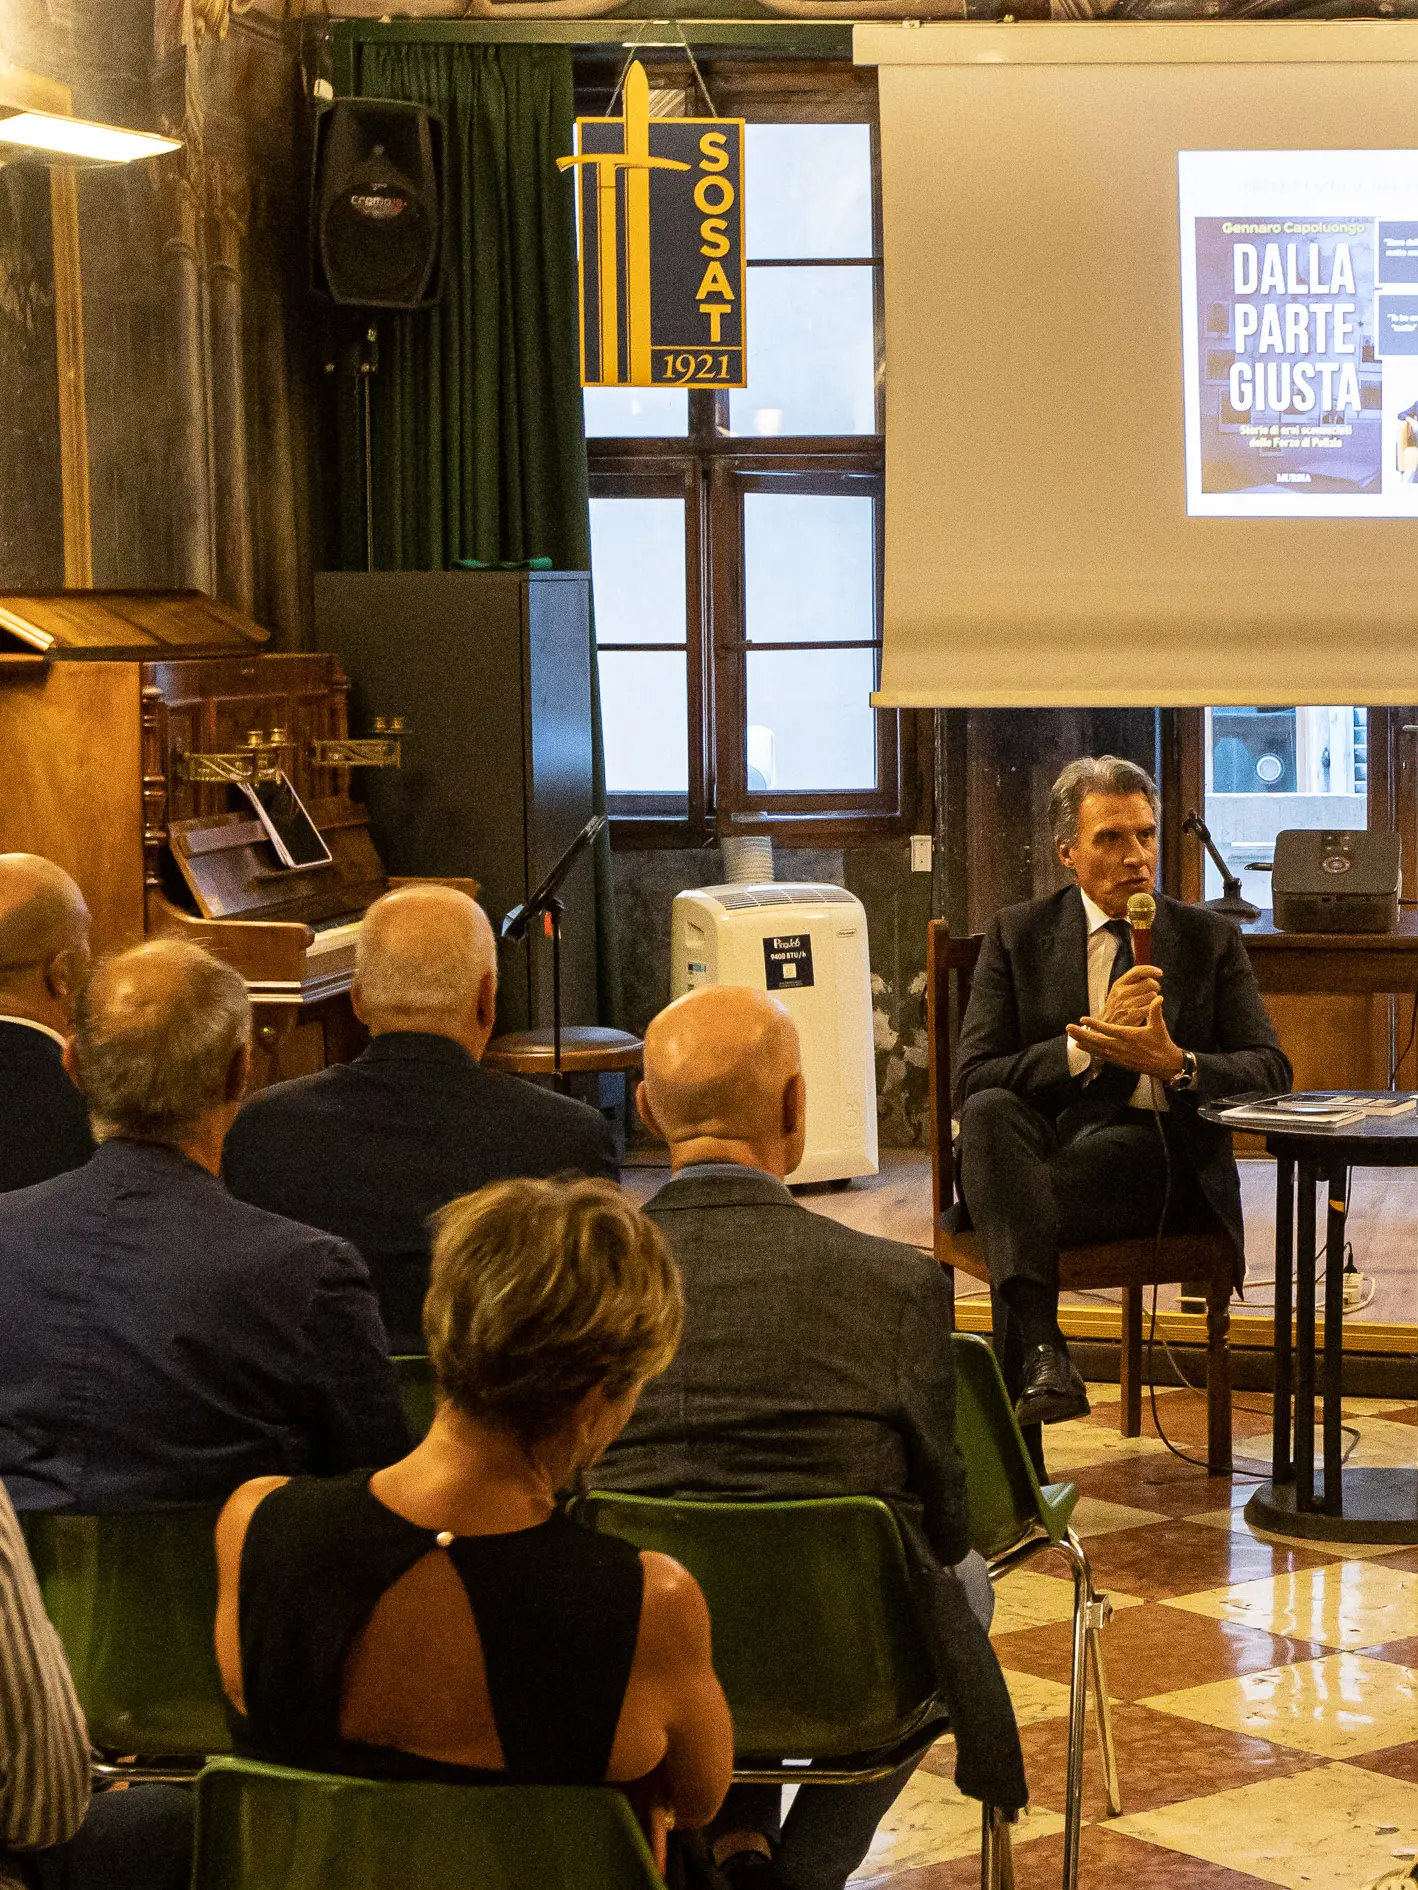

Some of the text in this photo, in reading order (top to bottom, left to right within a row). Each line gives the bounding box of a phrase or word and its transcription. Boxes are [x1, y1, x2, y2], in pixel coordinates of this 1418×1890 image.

[693, 131, 735, 343] SOSAT
[1221, 222, 1365, 236] Gennaro Capoluongo
[1233, 243, 1356, 295] DALLA
[1234, 303, 1356, 354] PARTE
[662, 353, 730, 385] 1921
[1228, 361, 1363, 412] GIUSTA
[1269, 424, 1279, 435] di
[1273, 437, 1301, 448] Forze
